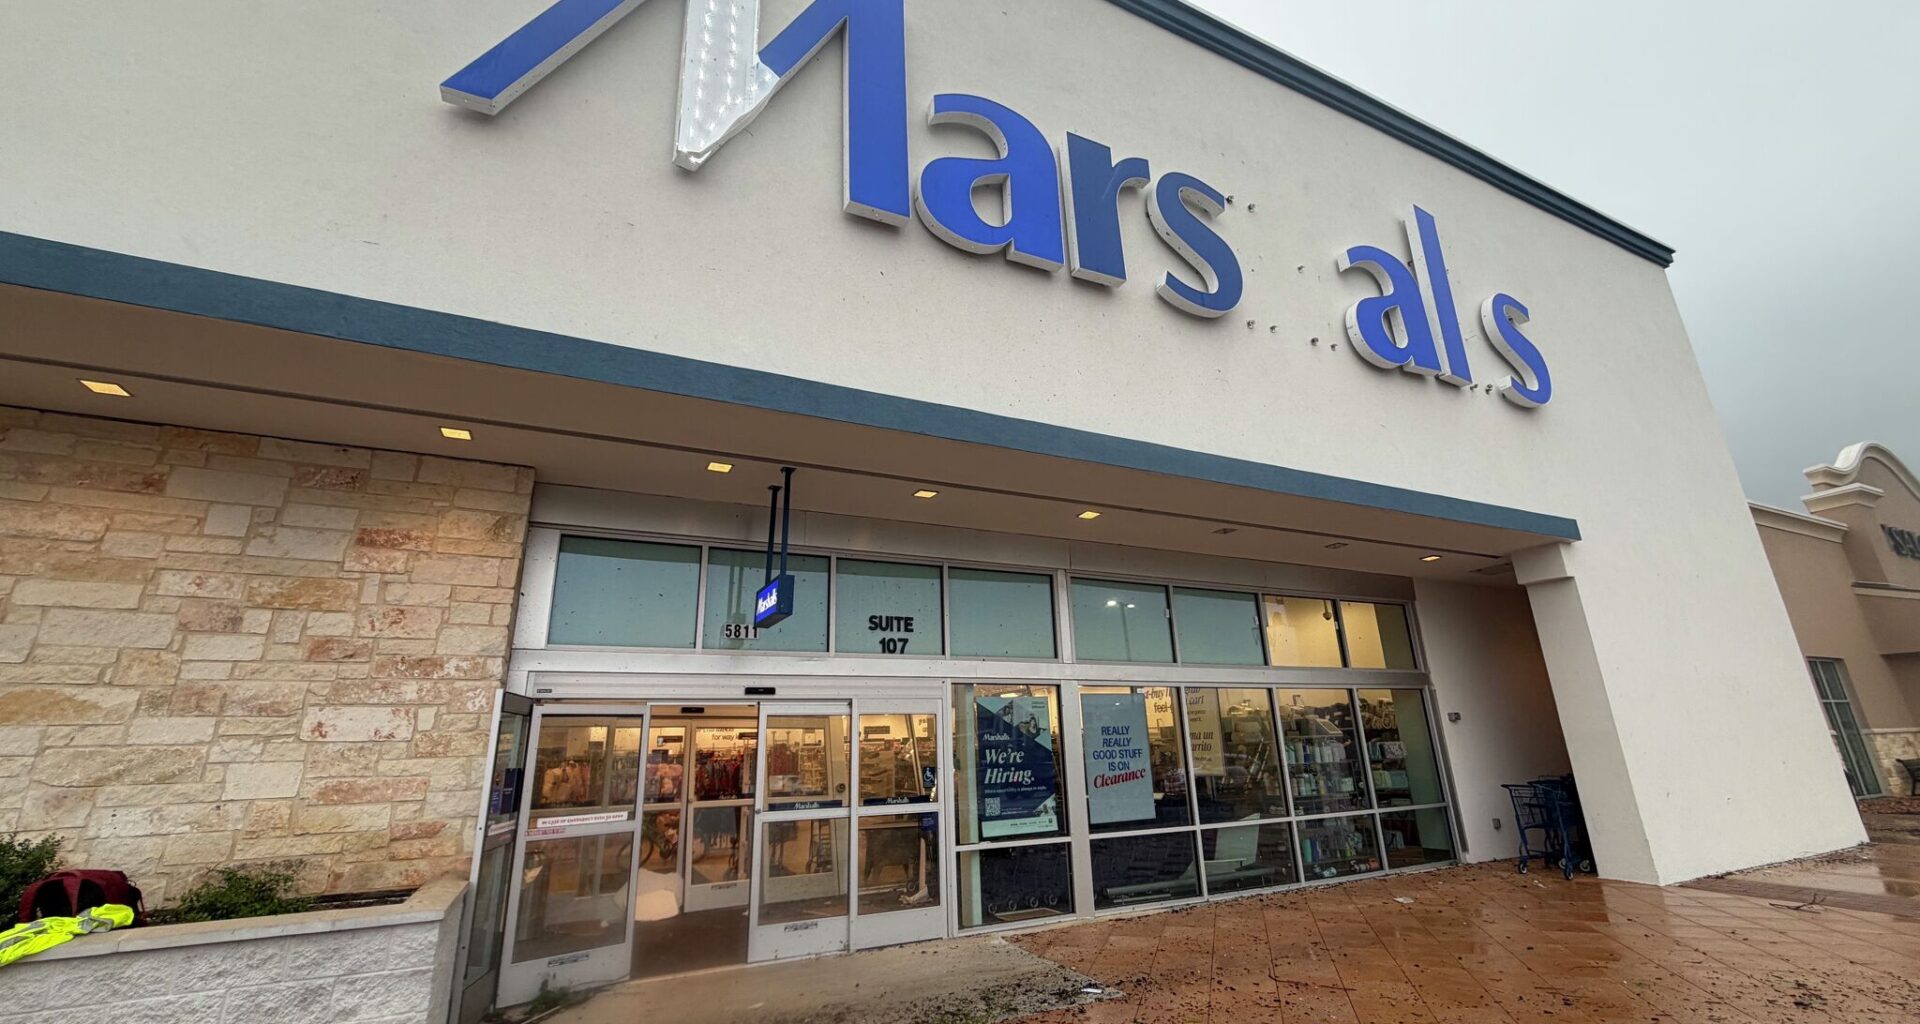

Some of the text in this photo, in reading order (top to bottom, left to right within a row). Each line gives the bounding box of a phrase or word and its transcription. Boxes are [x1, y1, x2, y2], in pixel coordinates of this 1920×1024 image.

[868, 615, 914, 632] SUITE
[725, 624, 758, 638] 5811
[878, 637, 909, 654] 107
[982, 732, 1011, 741] Marshalls
[1101, 726, 1130, 736] REALLY
[1102, 737, 1132, 748] REALLY
[985, 748, 1025, 764] We're
[1093, 748, 1143, 760] GOOD STUFF
[1108, 761, 1130, 772] IS ON
[984, 767, 1035, 786] Hiring.
[1093, 768, 1146, 789] Clearance
